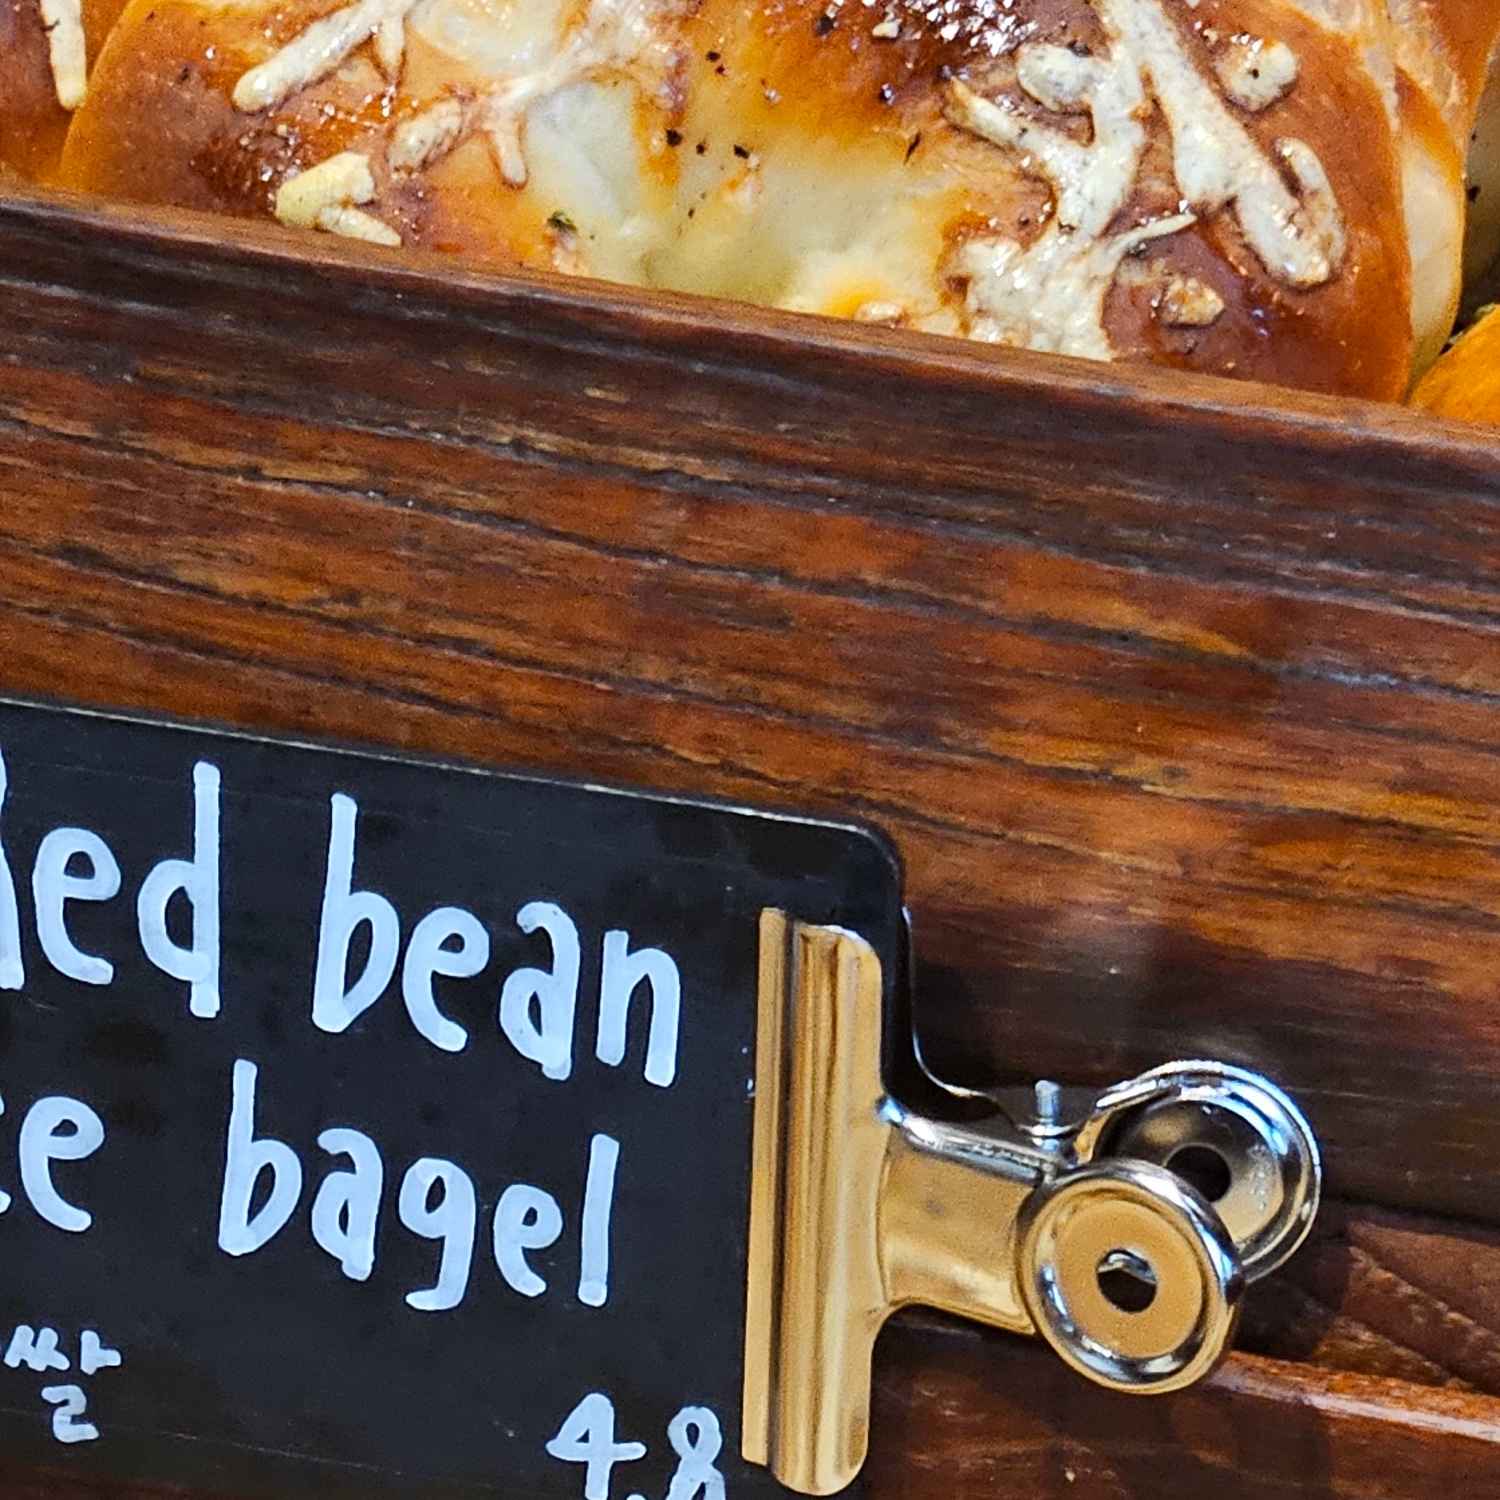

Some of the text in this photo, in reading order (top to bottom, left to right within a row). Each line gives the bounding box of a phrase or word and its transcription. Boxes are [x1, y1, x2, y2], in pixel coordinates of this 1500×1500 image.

[311, 792, 682, 1089] bean
[0, 1058, 621, 1312] e bagel
[2, 1324, 122, 1444] 쌀
